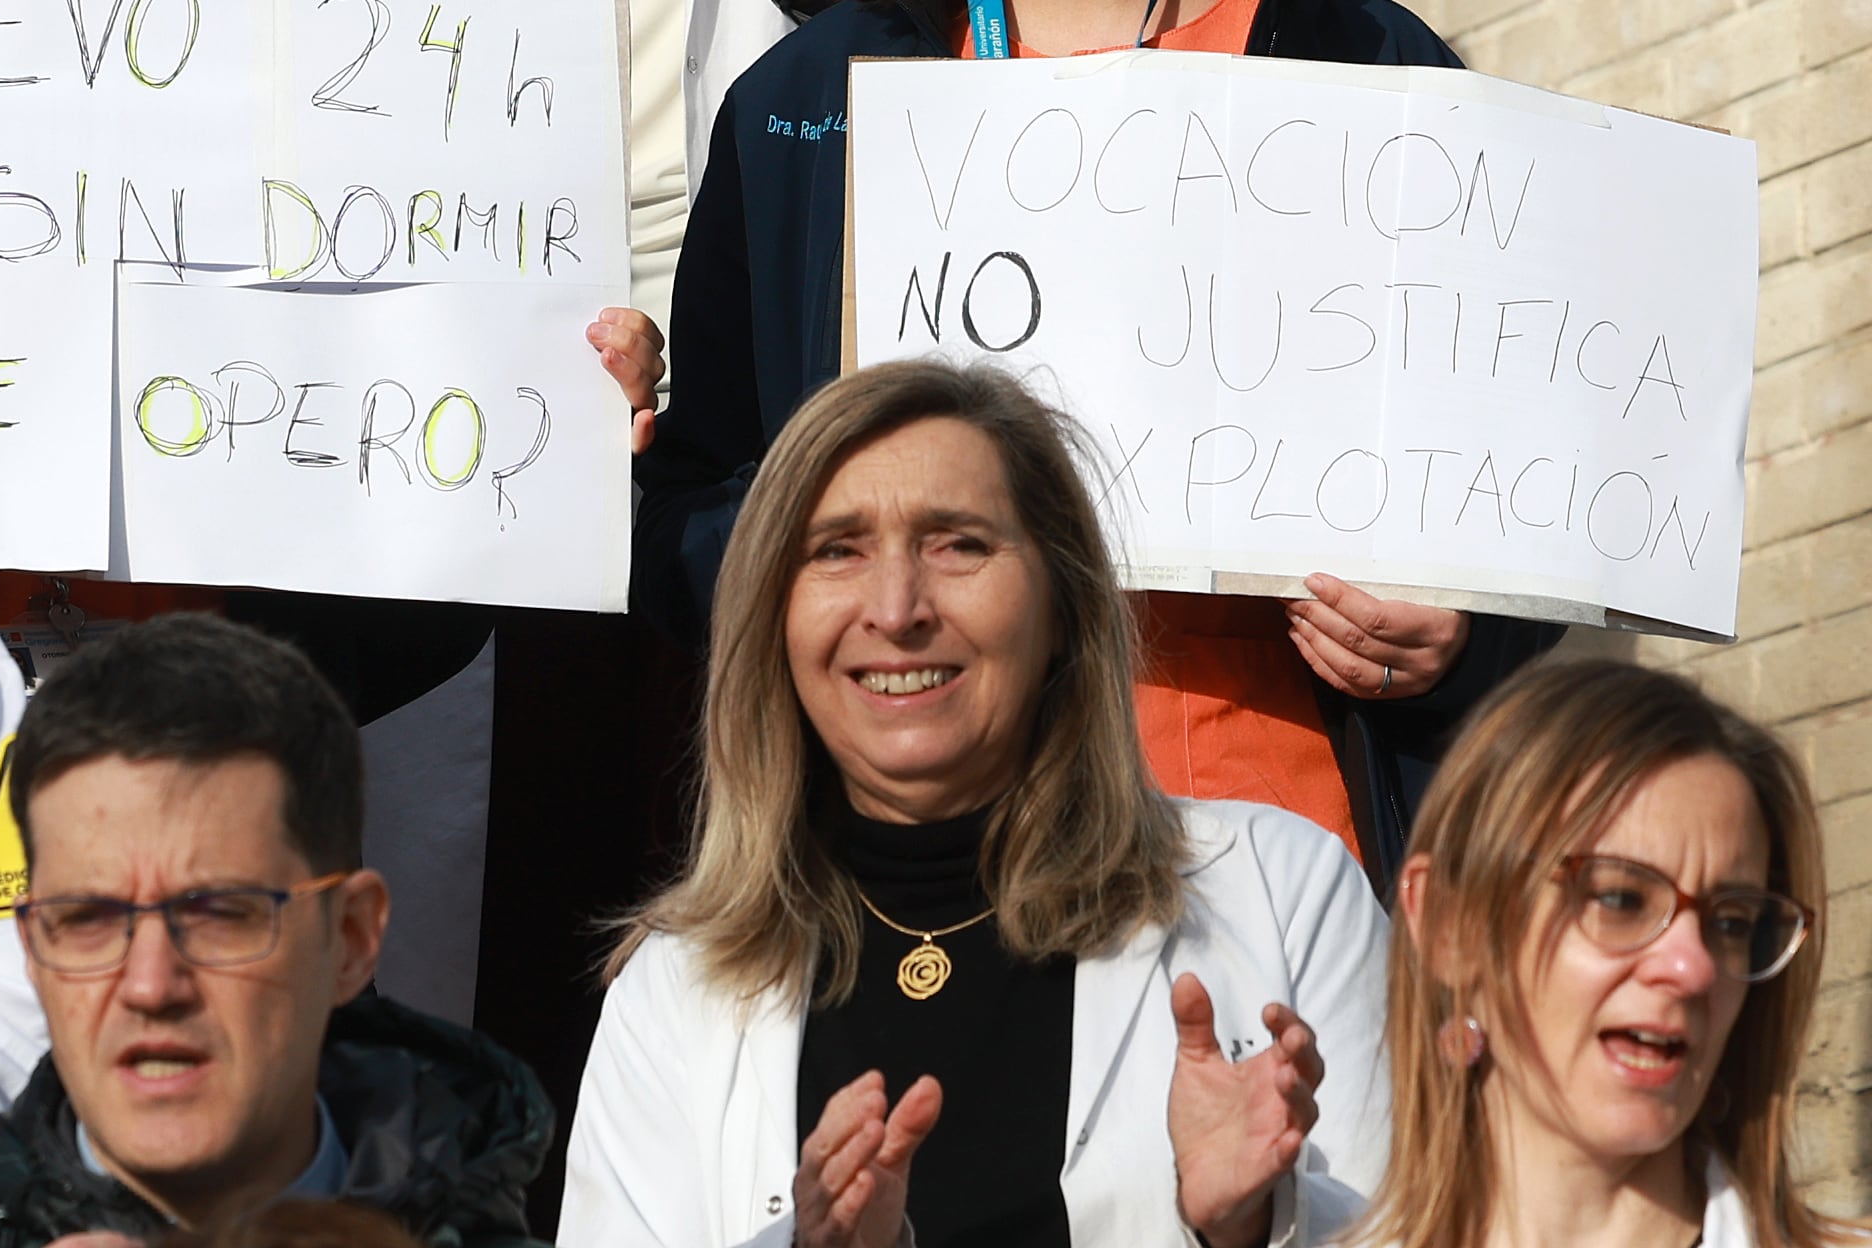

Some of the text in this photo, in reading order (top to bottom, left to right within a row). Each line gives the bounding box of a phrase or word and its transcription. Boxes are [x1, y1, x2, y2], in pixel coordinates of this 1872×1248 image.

[507, 28, 553, 127] h
[975, 5, 988, 56] Universitario
[989, 18, 1004, 58] arañón
[767, 114, 795, 136] Dra.
[907, 105, 1535, 251] VOCACIÓN
[262, 176, 581, 282] DORMIR
[898, 251, 1687, 421] NO JUSTIFICA
[133, 361, 551, 532] OPERO?
[1094, 423, 1710, 572] XPLOTACIÓN
